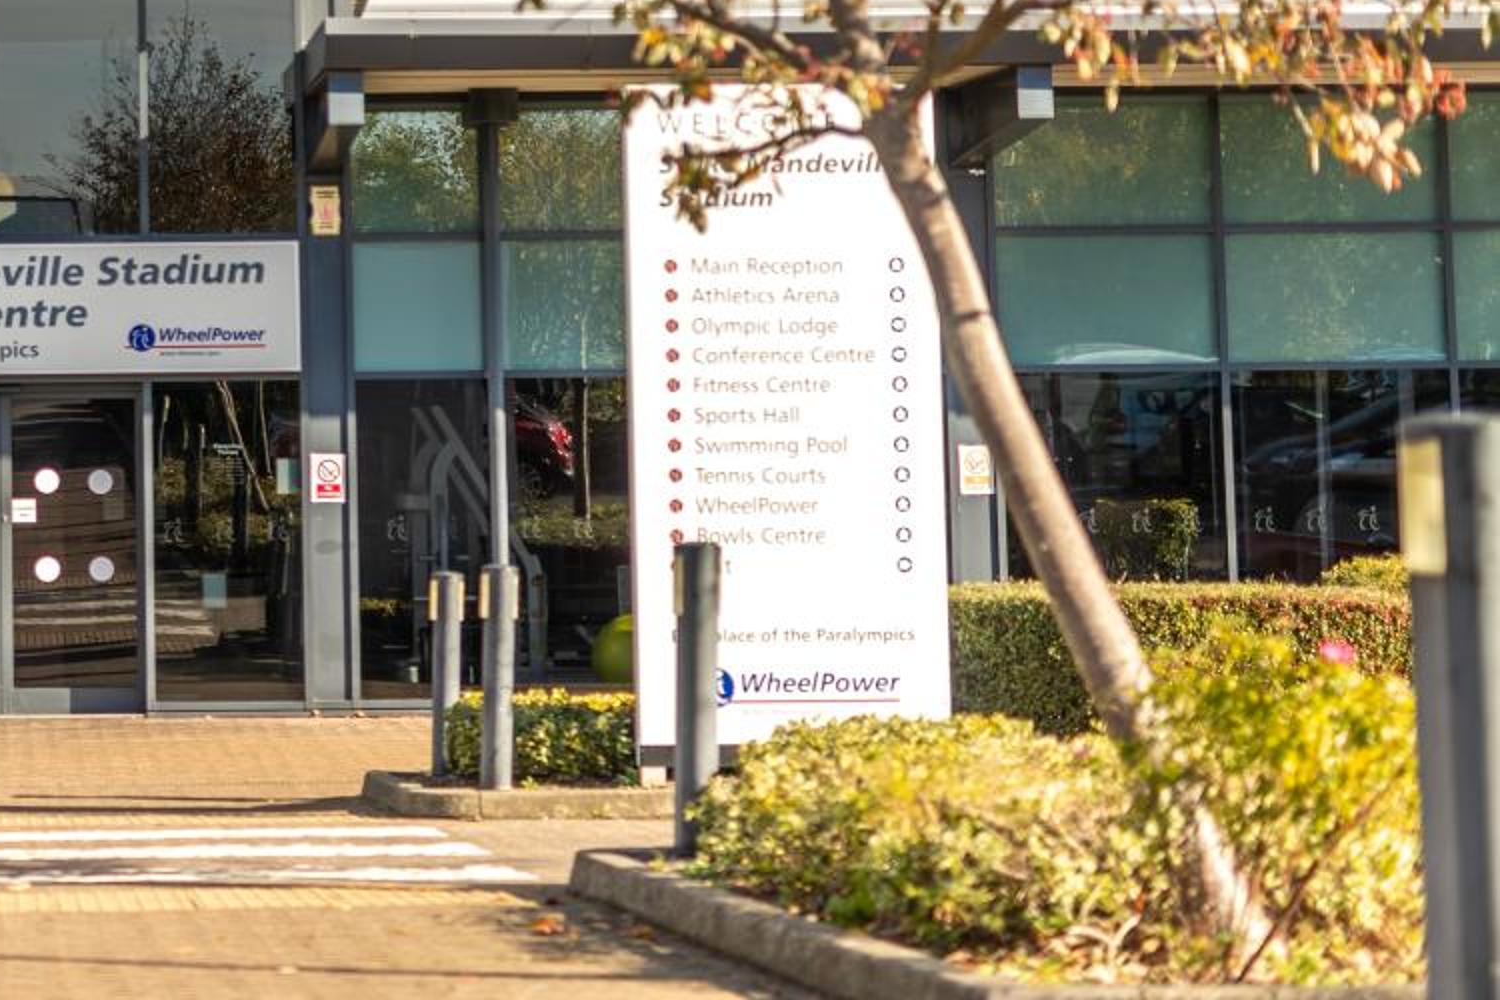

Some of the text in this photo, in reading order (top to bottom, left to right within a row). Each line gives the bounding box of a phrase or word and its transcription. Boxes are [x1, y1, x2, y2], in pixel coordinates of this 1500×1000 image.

[659, 185, 774, 208] Sdium
[97, 254, 265, 286] Stadium
[690, 256, 843, 278] Main Reception
[691, 286, 840, 304] Athletics Arena
[158, 327, 265, 342] WheelPower
[691, 316, 839, 339] Olympic Lodge
[692, 346, 876, 365] Conference Centre
[693, 376, 831, 393] Fitness Centre
[694, 406, 800, 427] Sports Hall
[694, 435, 848, 458] Swimming Pool
[695, 467, 826, 484] Tennis Courts
[695, 496, 818, 515] WheelPower
[697, 527, 826, 545] Bowls Centre
[761, 628, 778, 643] of
[783, 628, 811, 643] the
[817, 628, 915, 646] Paralympics
[741, 671, 900, 693] WheelPower
